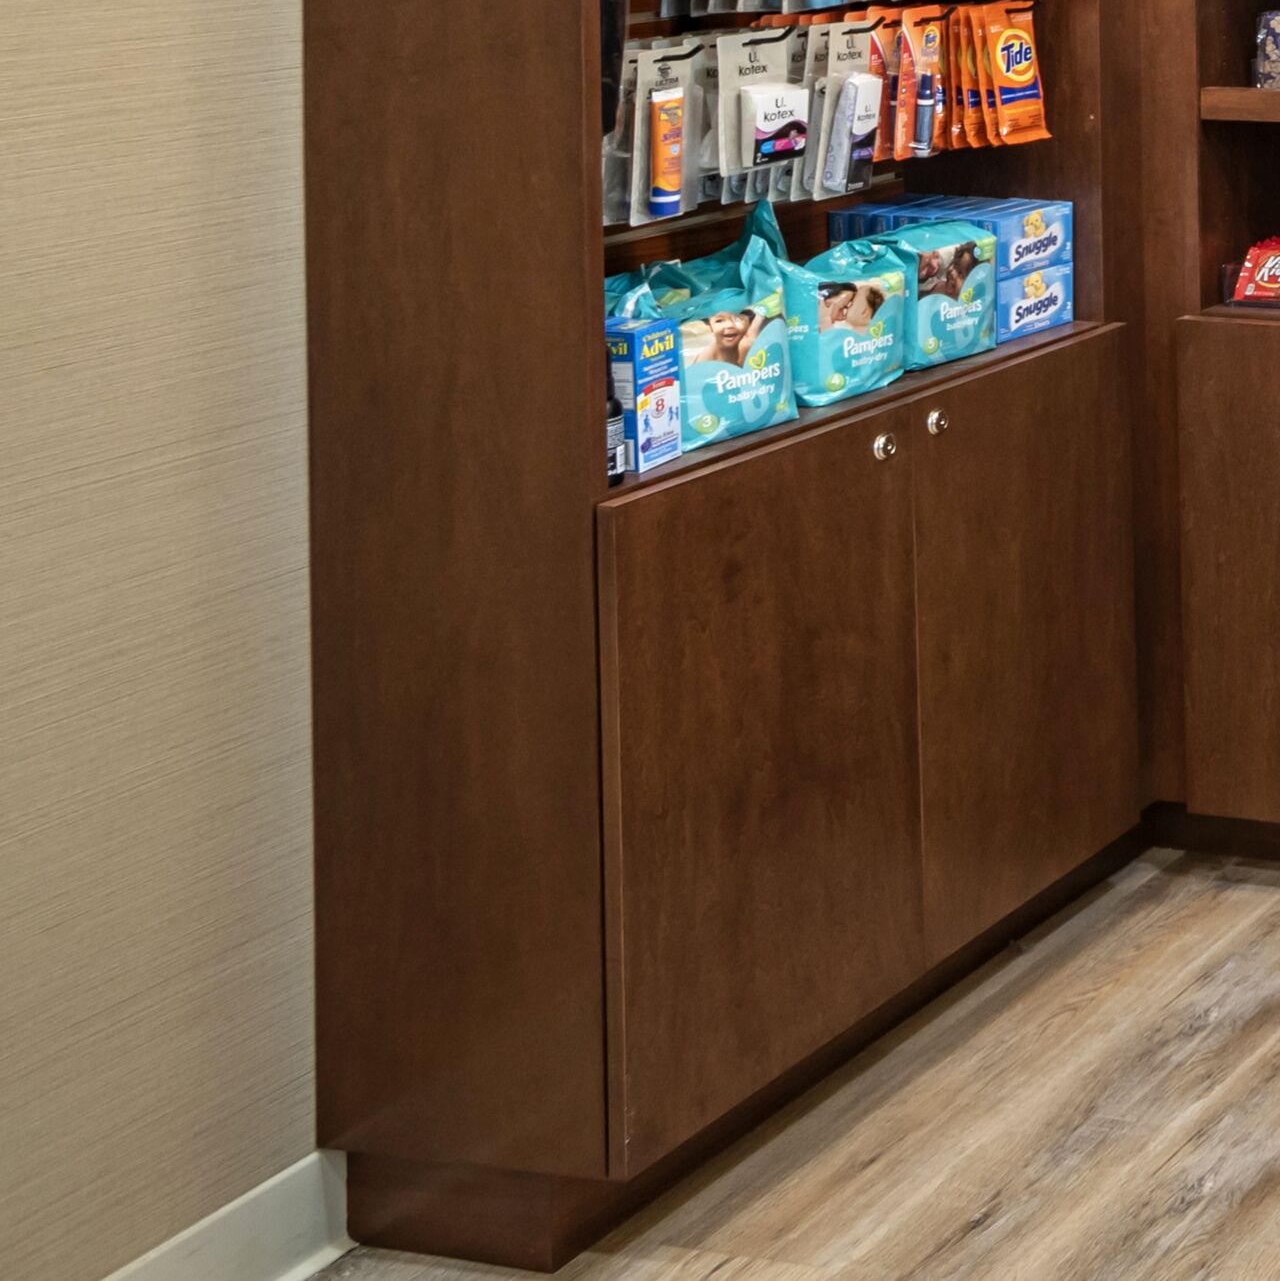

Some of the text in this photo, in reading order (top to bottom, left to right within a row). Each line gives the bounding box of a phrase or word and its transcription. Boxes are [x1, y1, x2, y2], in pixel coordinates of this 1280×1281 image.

[837, 48, 862, 61] kotex
[1001, 41, 1032, 73] Tide
[739, 64, 767, 77] kotex
[763, 109, 794, 123] kotex
[1014, 233, 1058, 263] Snuggle
[940, 299, 982, 321] Pampers
[1014, 292, 1059, 323] Snuggle
[640, 335, 674, 360] Advil
[843, 332, 893, 357] Pampers
[715, 361, 780, 393] Pampers
